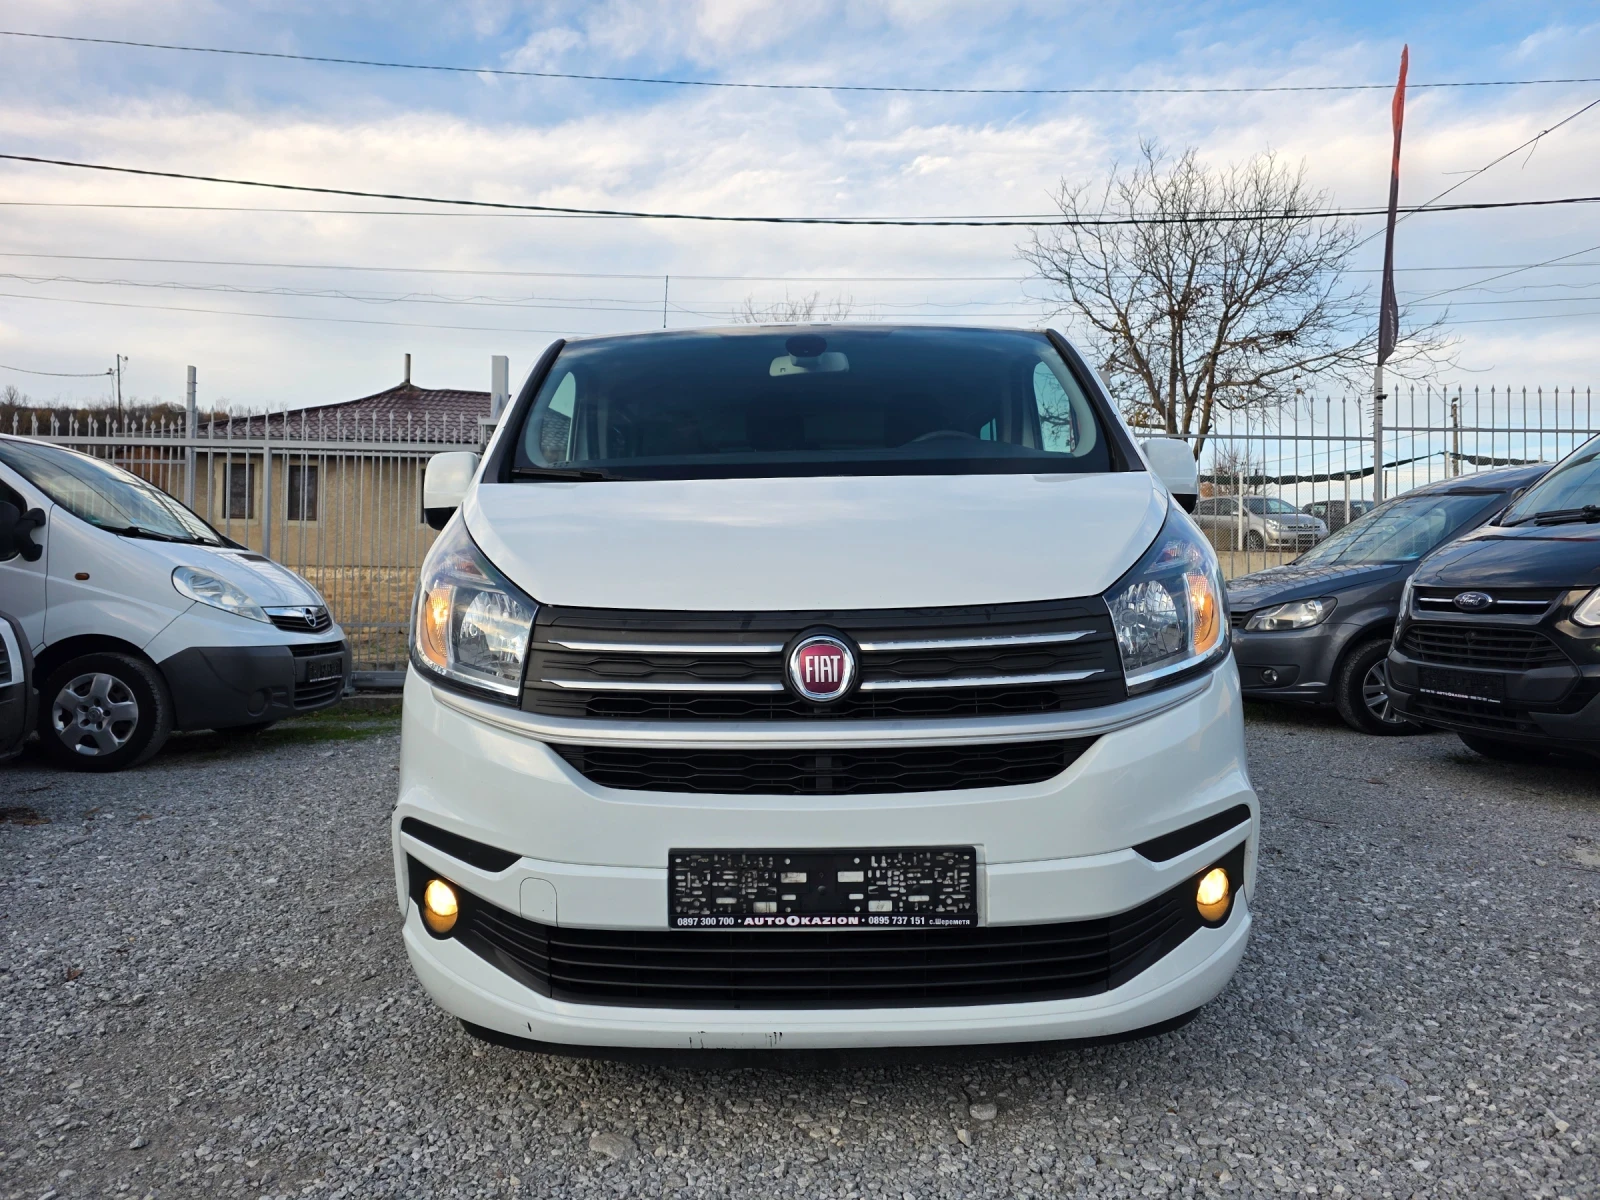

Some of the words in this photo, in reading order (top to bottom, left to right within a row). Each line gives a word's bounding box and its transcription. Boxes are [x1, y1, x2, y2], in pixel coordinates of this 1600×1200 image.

[1459, 594, 1481, 606] Ford
[805, 655, 841, 683] FIAT
[677, 917, 699, 926] 0897
[700, 917, 717, 926] 300
[718, 917, 735, 926] 700
[743, 915, 859, 926] AUTOOKAZION
[868, 916, 890, 926] 0895
[891, 916, 908, 925] 737
[909, 916, 925, 925] 151
